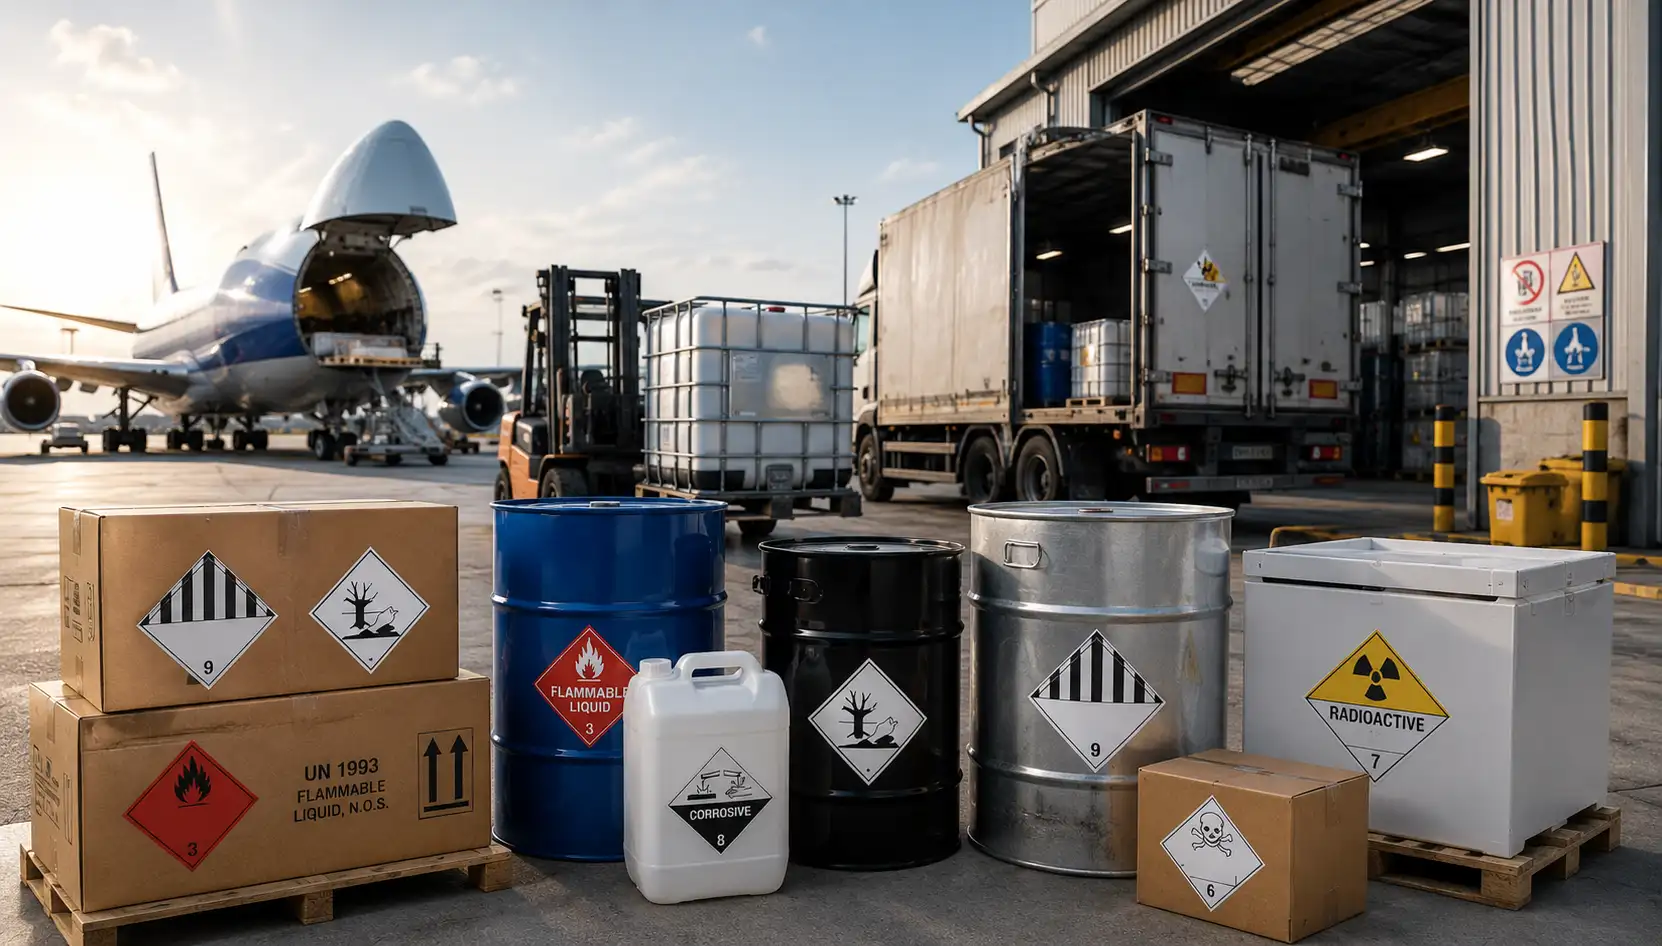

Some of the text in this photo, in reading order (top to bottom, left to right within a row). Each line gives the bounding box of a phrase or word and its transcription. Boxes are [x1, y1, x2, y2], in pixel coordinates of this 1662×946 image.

[204, 660, 214, 675] 9
[569, 701, 611, 714] LIQUID
[1329, 705, 1425, 732] RADIOACTIVE
[585, 722, 594, 735] 3
[1091, 742, 1101, 757] 9
[304, 757, 379, 781] UN 1993
[1371, 753, 1381, 769] 7
[297, 779, 386, 804] FLAMMABLE
[293, 797, 389, 823] LIQUID, N.O.S.
[689, 805, 752, 821] CORROSIVE
[716, 833, 726, 847] 8
[187, 841, 198, 857] 3
[1206, 883, 1216, 898] 6
